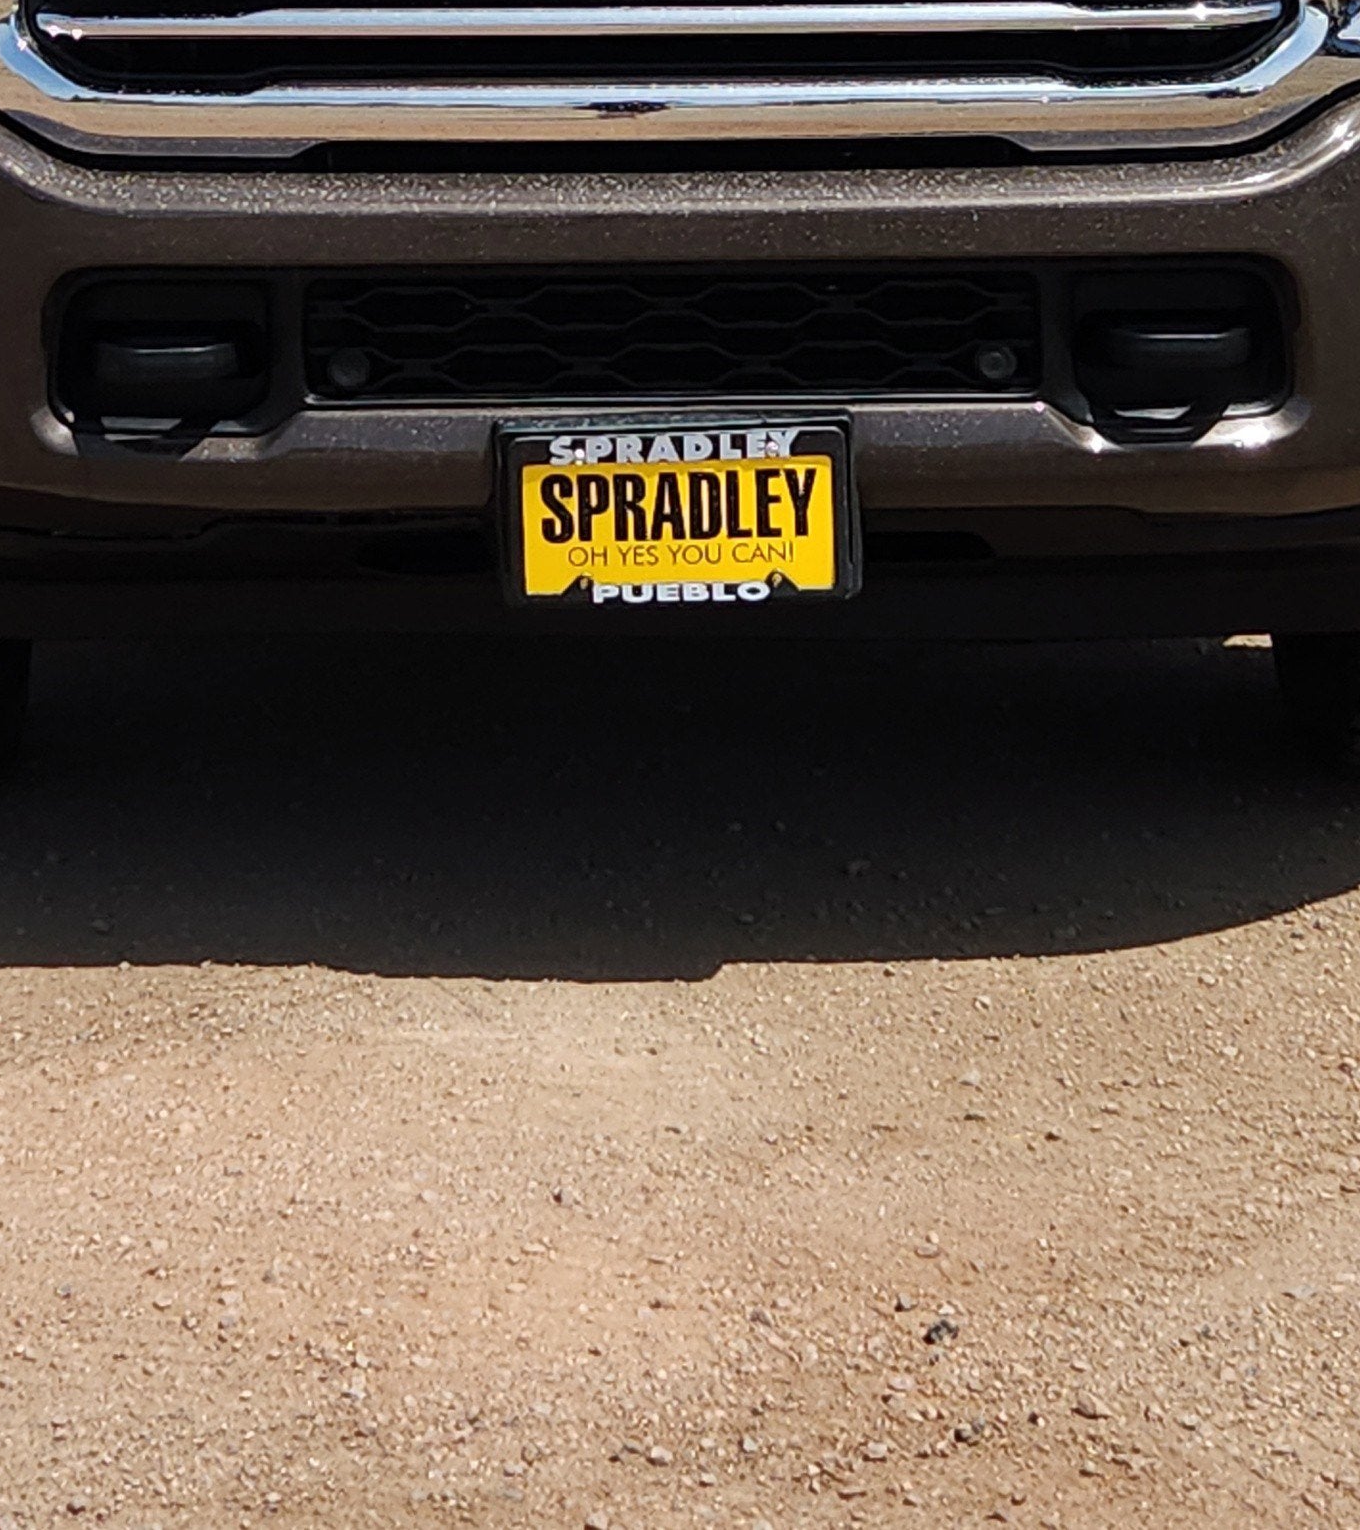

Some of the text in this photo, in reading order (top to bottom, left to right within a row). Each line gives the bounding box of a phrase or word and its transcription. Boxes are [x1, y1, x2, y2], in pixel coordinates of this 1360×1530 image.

[549, 429, 799, 466] SPRADLEY
[540, 468, 817, 543] SPRADLEY
[568, 541, 794, 567] OH YES YOU CAN!
[592, 581, 771, 604] PUEBLO
